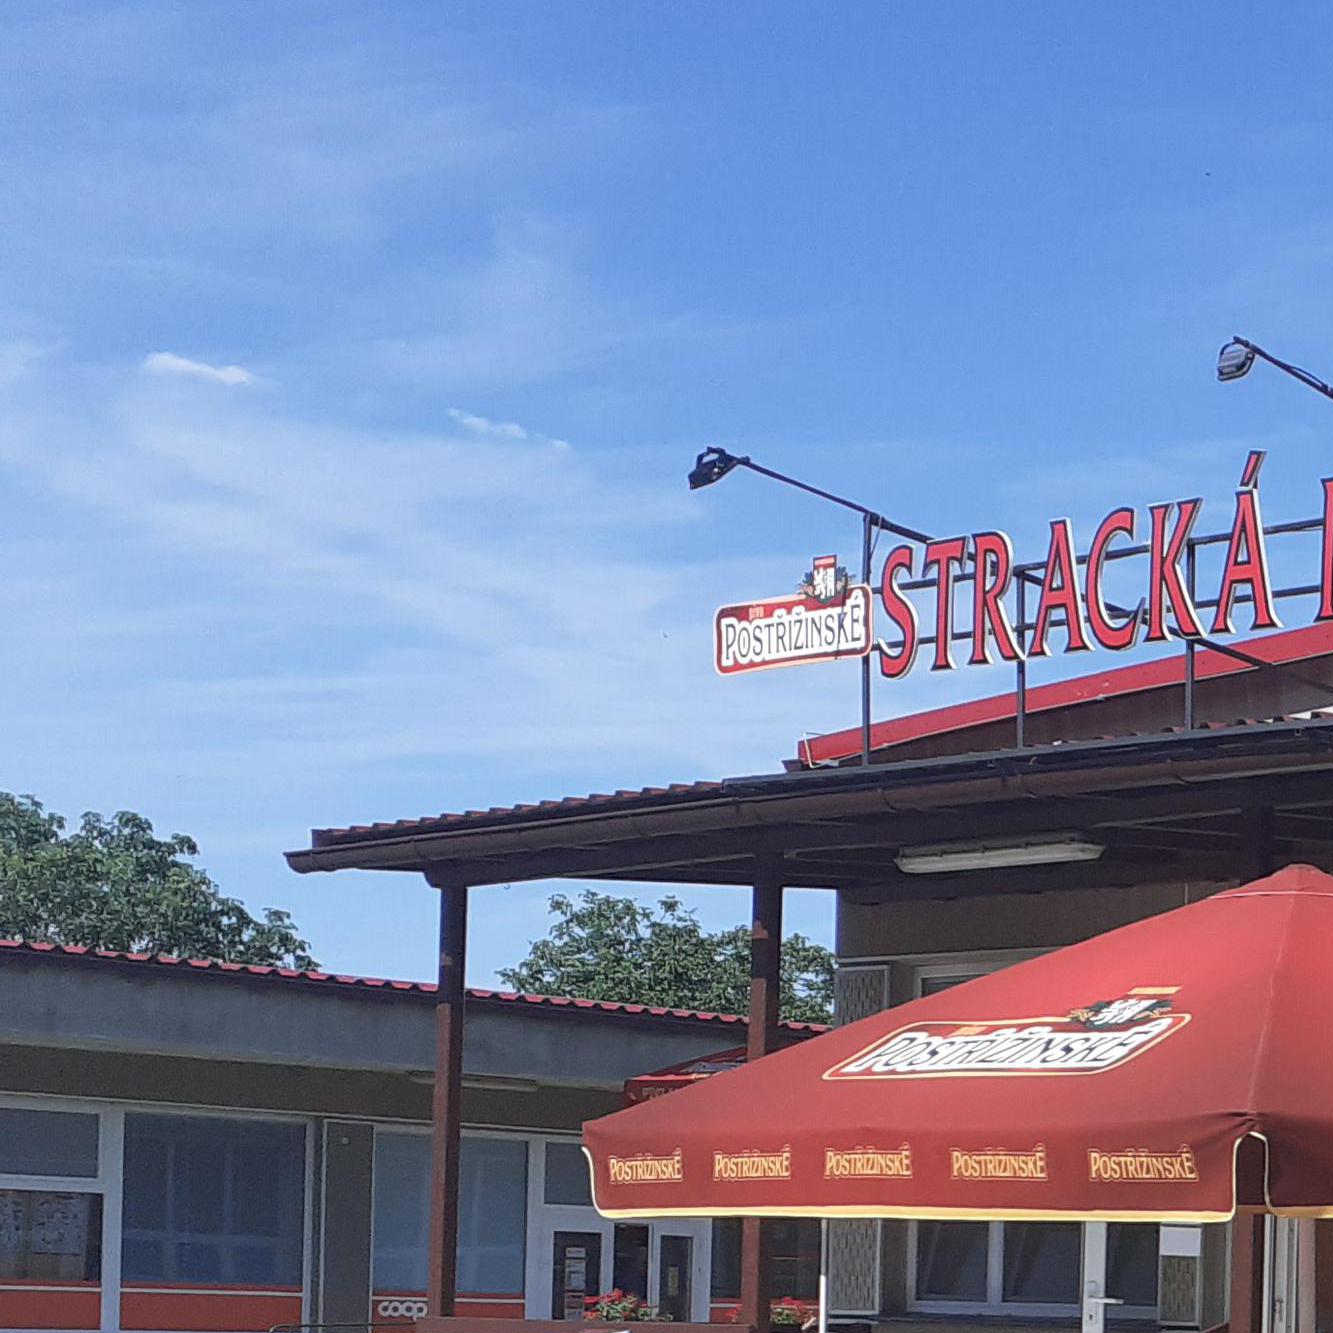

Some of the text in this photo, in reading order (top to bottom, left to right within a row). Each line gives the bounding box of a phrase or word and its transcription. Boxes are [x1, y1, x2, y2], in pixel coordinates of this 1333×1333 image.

[878, 449, 1284, 679] STRACKÁ
[724, 592, 862, 661] POSTŘIŽINSKÉ
[378, 1301, 428, 1320] coop
